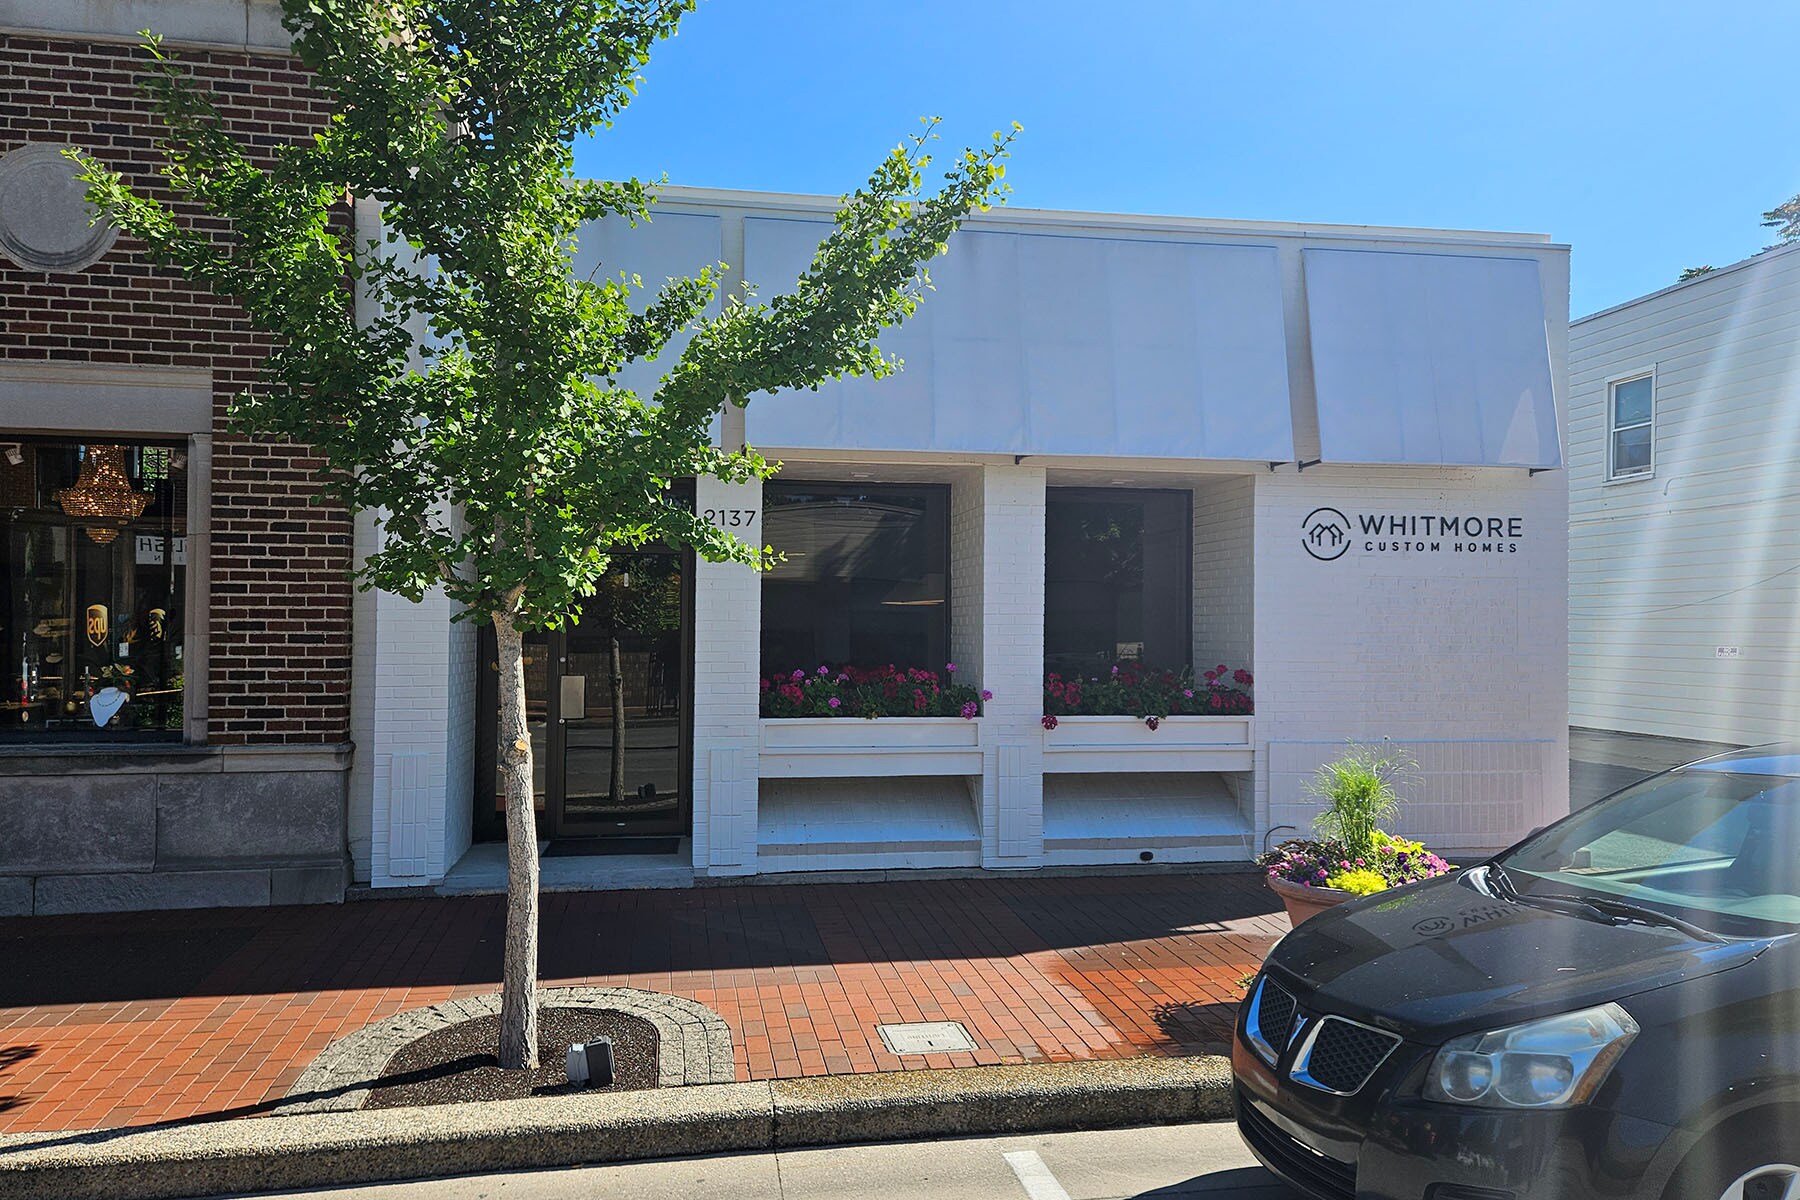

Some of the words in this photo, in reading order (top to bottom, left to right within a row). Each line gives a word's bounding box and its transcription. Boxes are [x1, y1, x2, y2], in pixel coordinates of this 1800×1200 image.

[704, 509, 756, 527] 2137
[1358, 514, 1523, 538] WHITMORE
[1365, 541, 1441, 552] CUSTOM
[1454, 542, 1518, 553] HOMES
